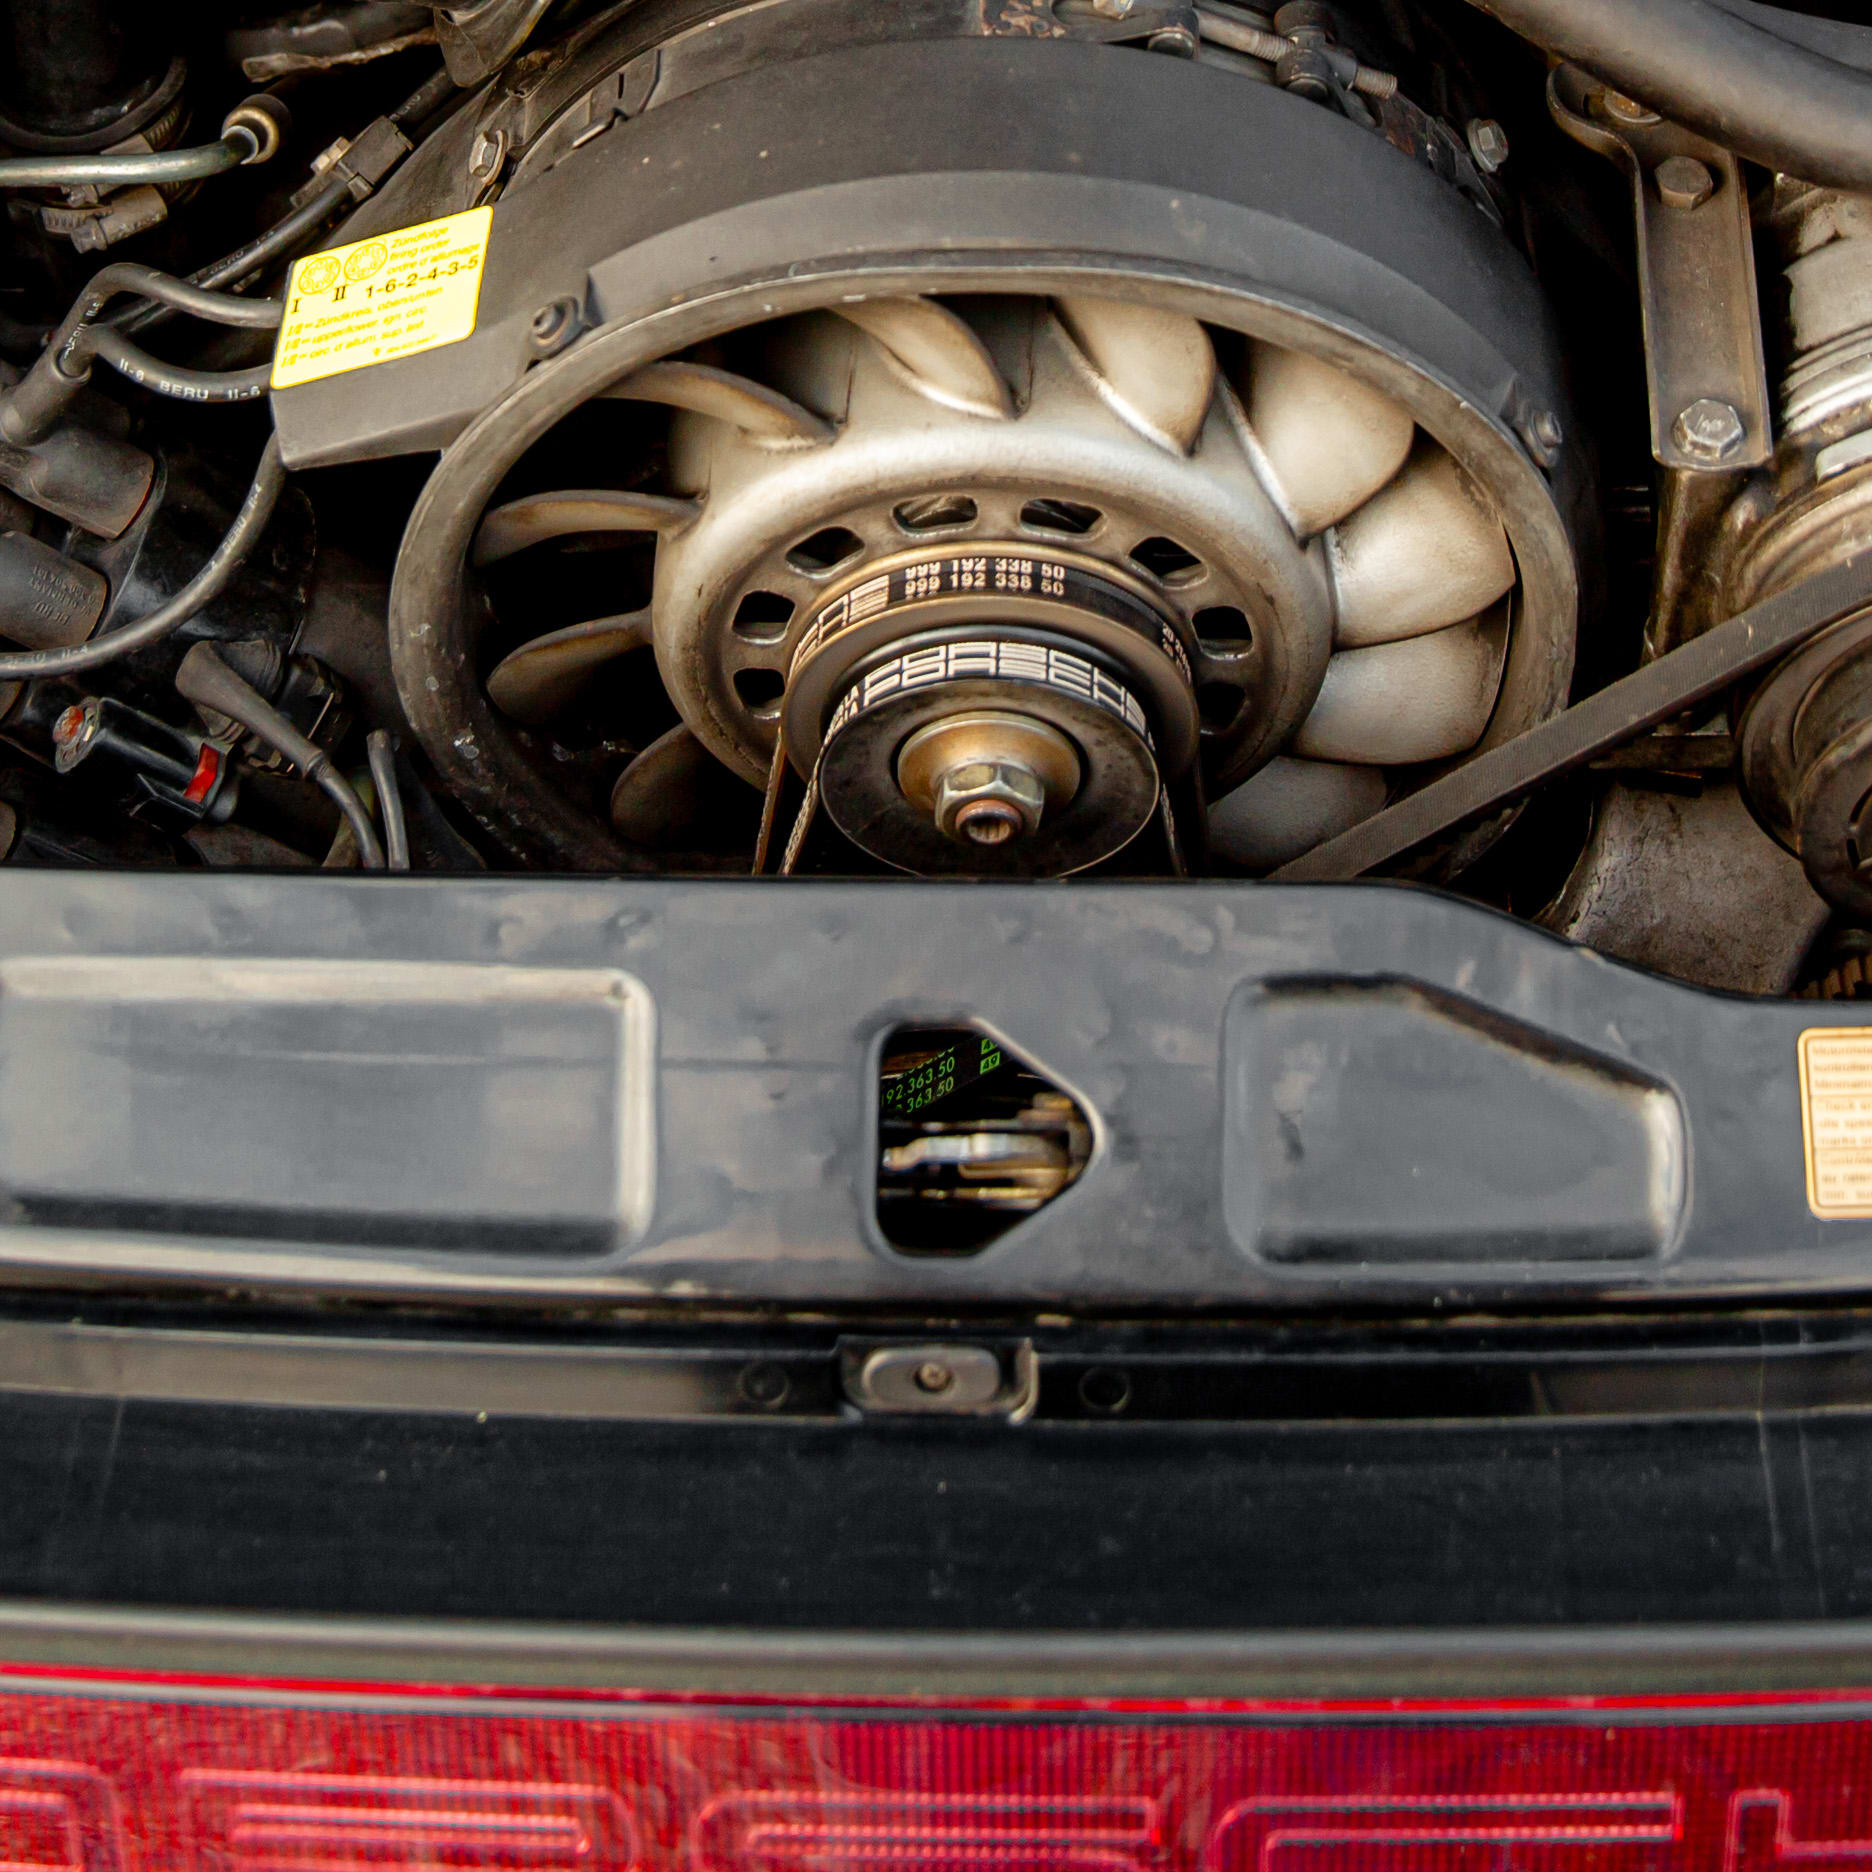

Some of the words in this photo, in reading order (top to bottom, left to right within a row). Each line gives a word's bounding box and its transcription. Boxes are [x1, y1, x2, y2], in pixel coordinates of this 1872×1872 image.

[365, 254, 480, 300] 1-6-2-4-3-5
[159, 380, 210, 400] BERU
[1041, 563, 1066, 581] 50
[905, 575, 941, 596] 999
[950, 572, 986, 589] 192
[1040, 578, 1066, 598] 50
